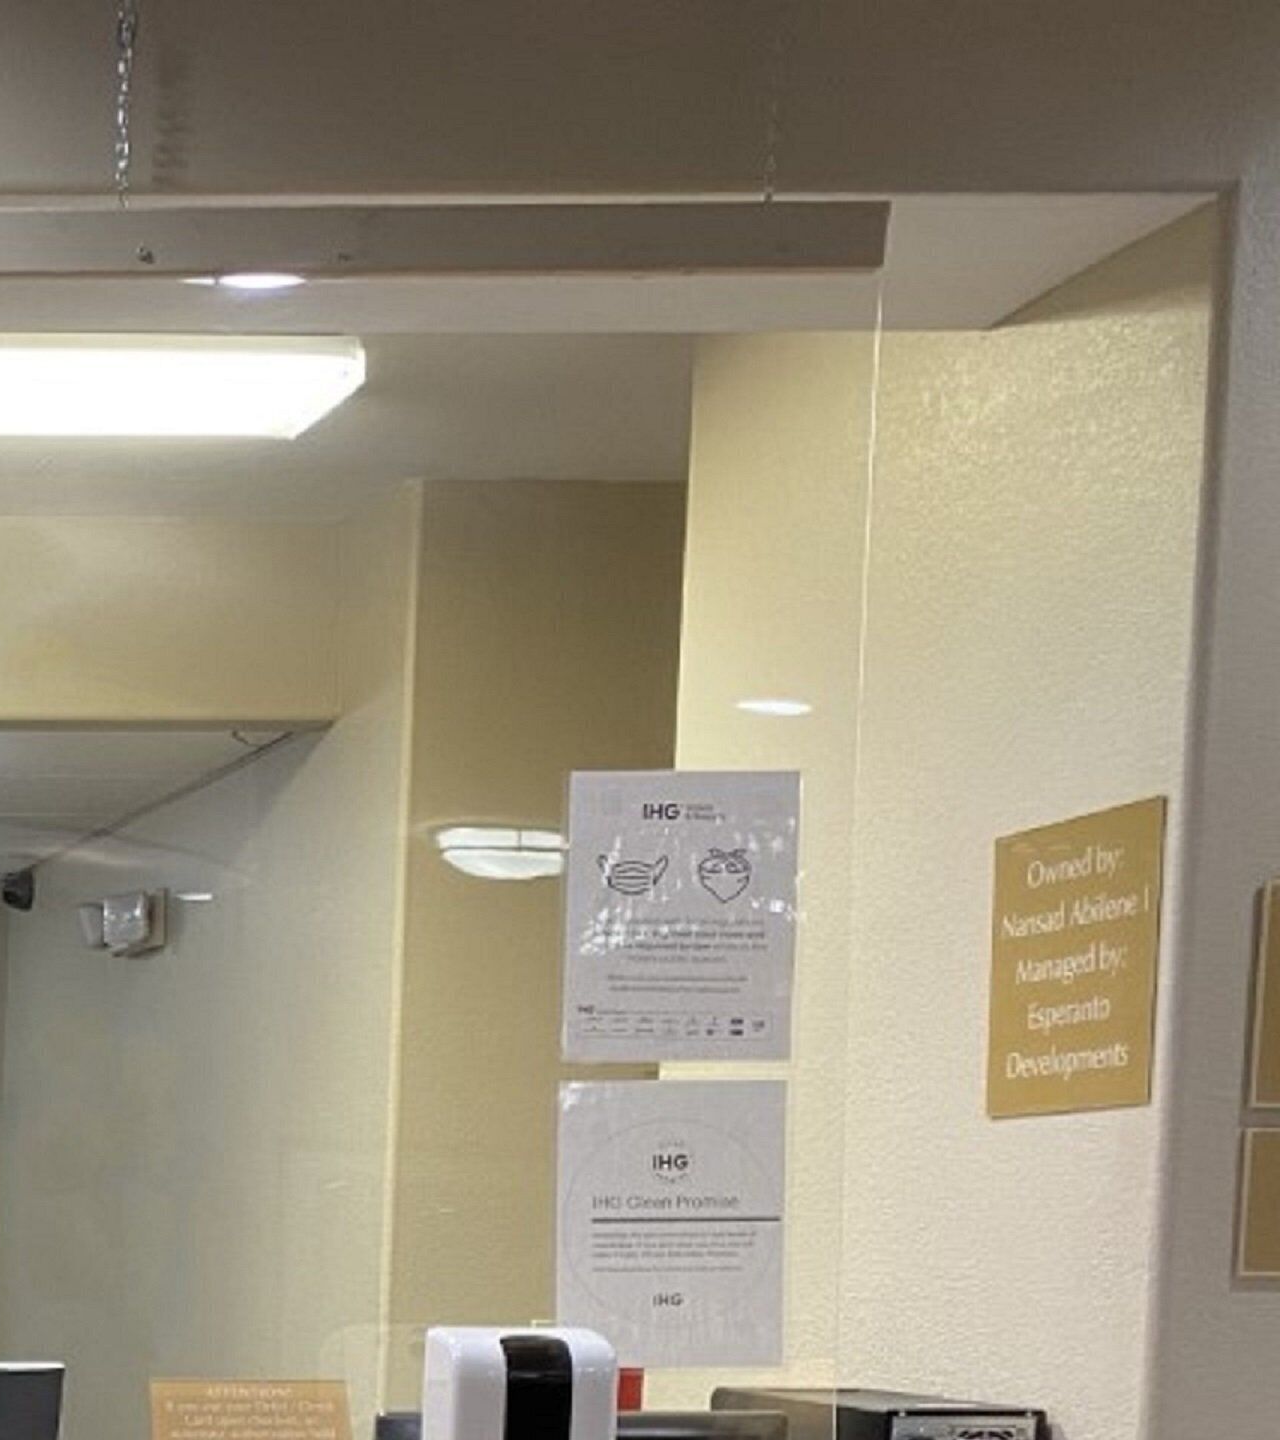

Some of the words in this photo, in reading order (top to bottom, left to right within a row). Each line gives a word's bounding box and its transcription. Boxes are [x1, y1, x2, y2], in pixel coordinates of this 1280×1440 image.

[643, 803, 680, 820] IHG
[1027, 846, 1092, 889] Owned
[1001, 899, 1065, 938] Nansad
[1070, 891, 1138, 926] Abilene
[1015, 942, 1096, 985] Managed
[1026, 995, 1111, 1035] Esperanto
[1005, 1043, 1129, 1081] Developments
[652, 1153, 689, 1171] IHG
[652, 1292, 684, 1306] IHG
